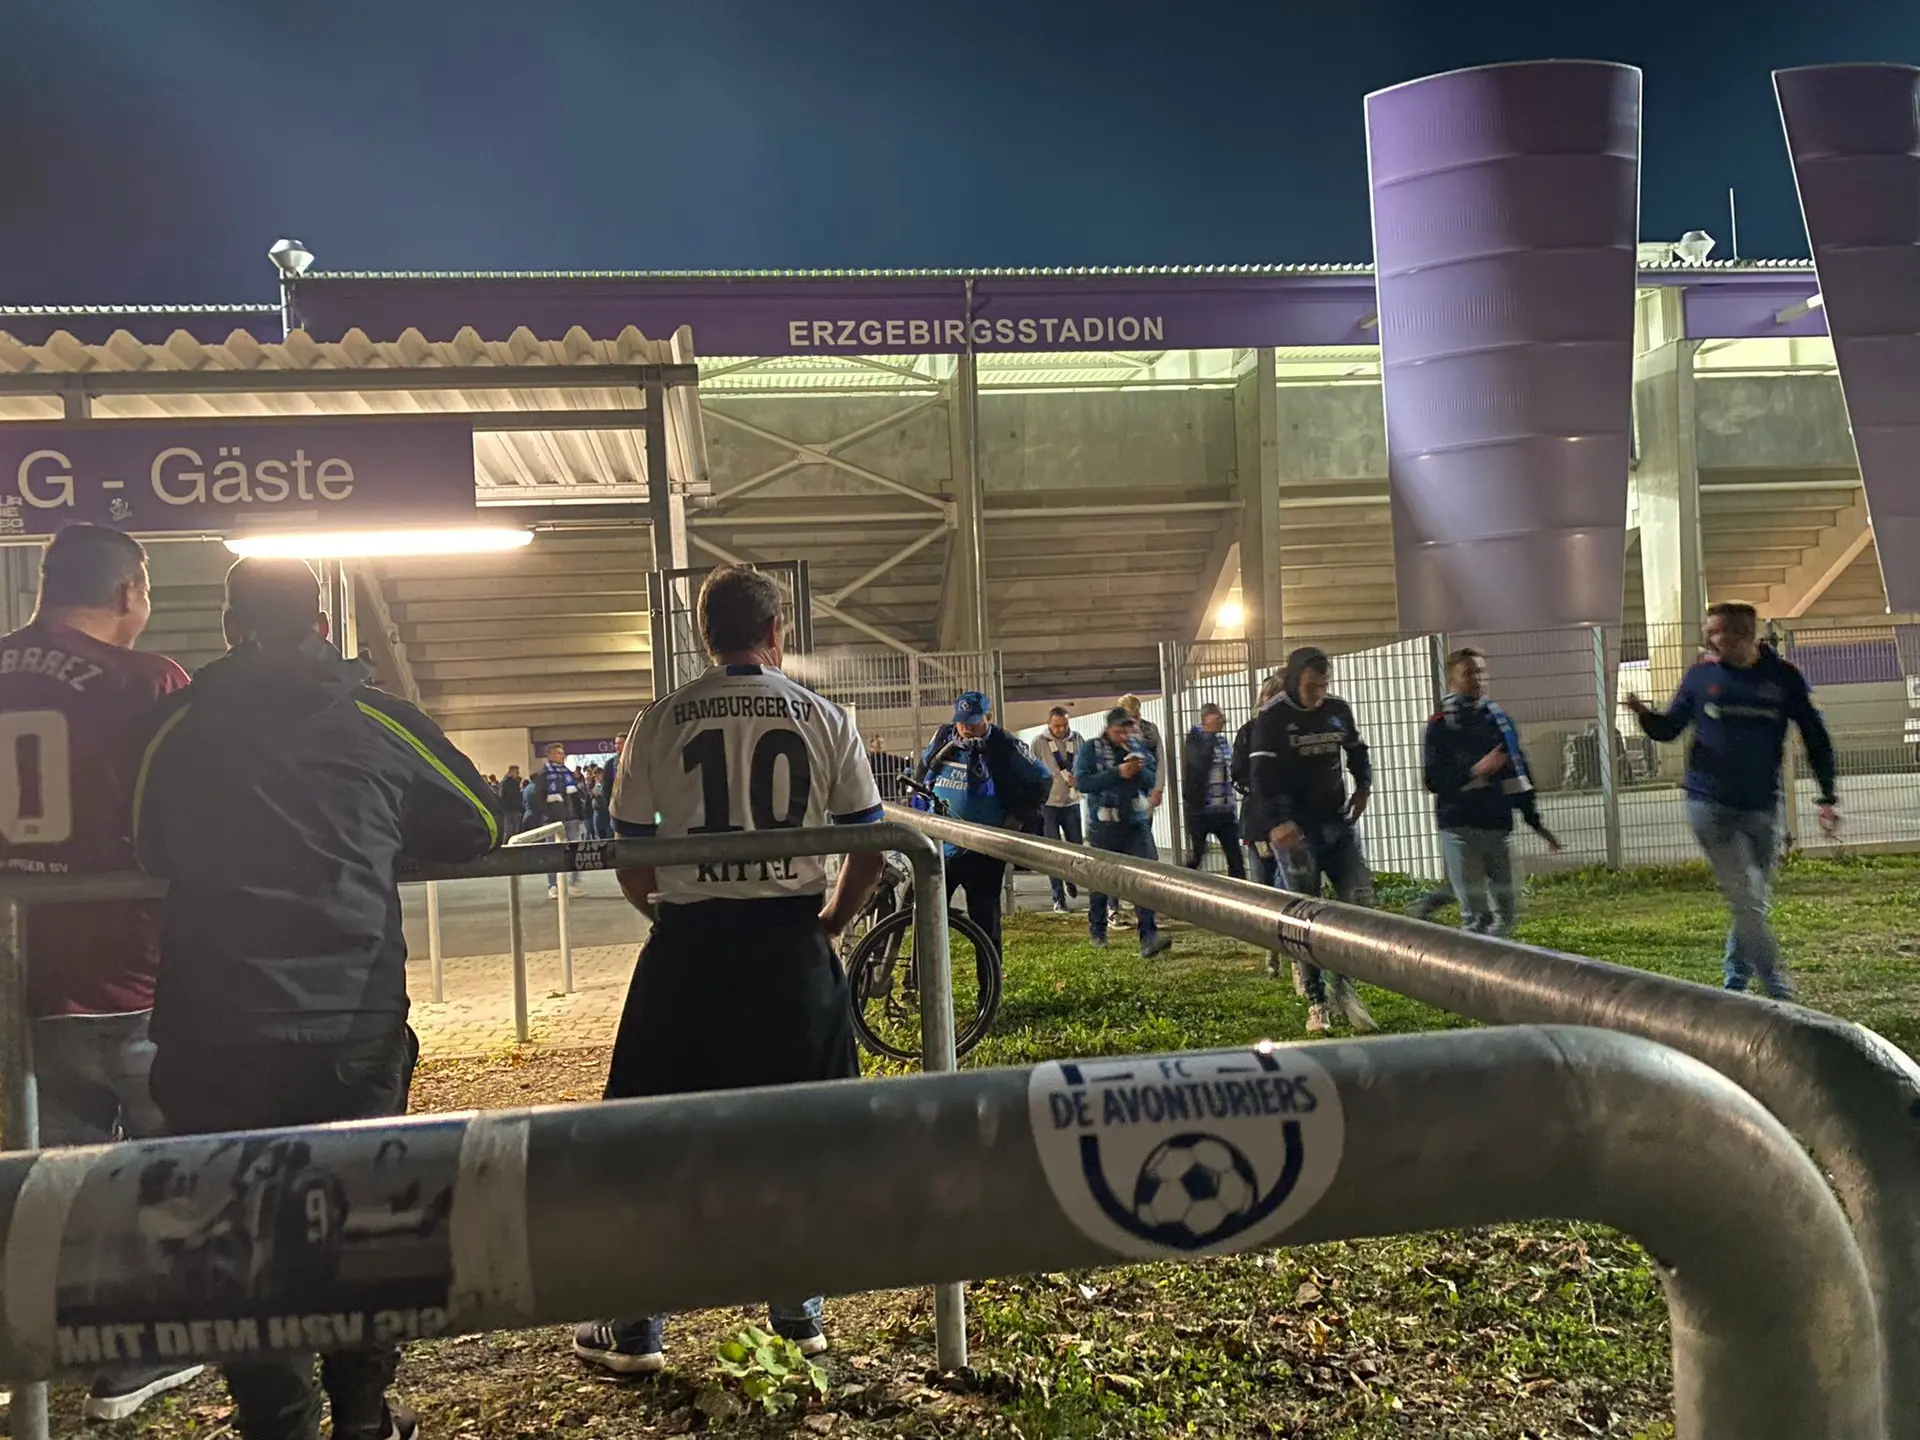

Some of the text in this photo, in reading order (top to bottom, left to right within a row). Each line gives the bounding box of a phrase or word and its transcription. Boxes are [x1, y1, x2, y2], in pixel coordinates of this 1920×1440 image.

[788, 316, 1164, 346] ERZGEBIRGSSTADION
[17, 446, 355, 509] G - Gäste
[674, 696, 812, 726] HAMBURGER SV
[682, 728, 812, 834] 10
[1159, 1061, 1192, 1080] FC
[1048, 1075, 1319, 1129] DE AVONTURIERS
